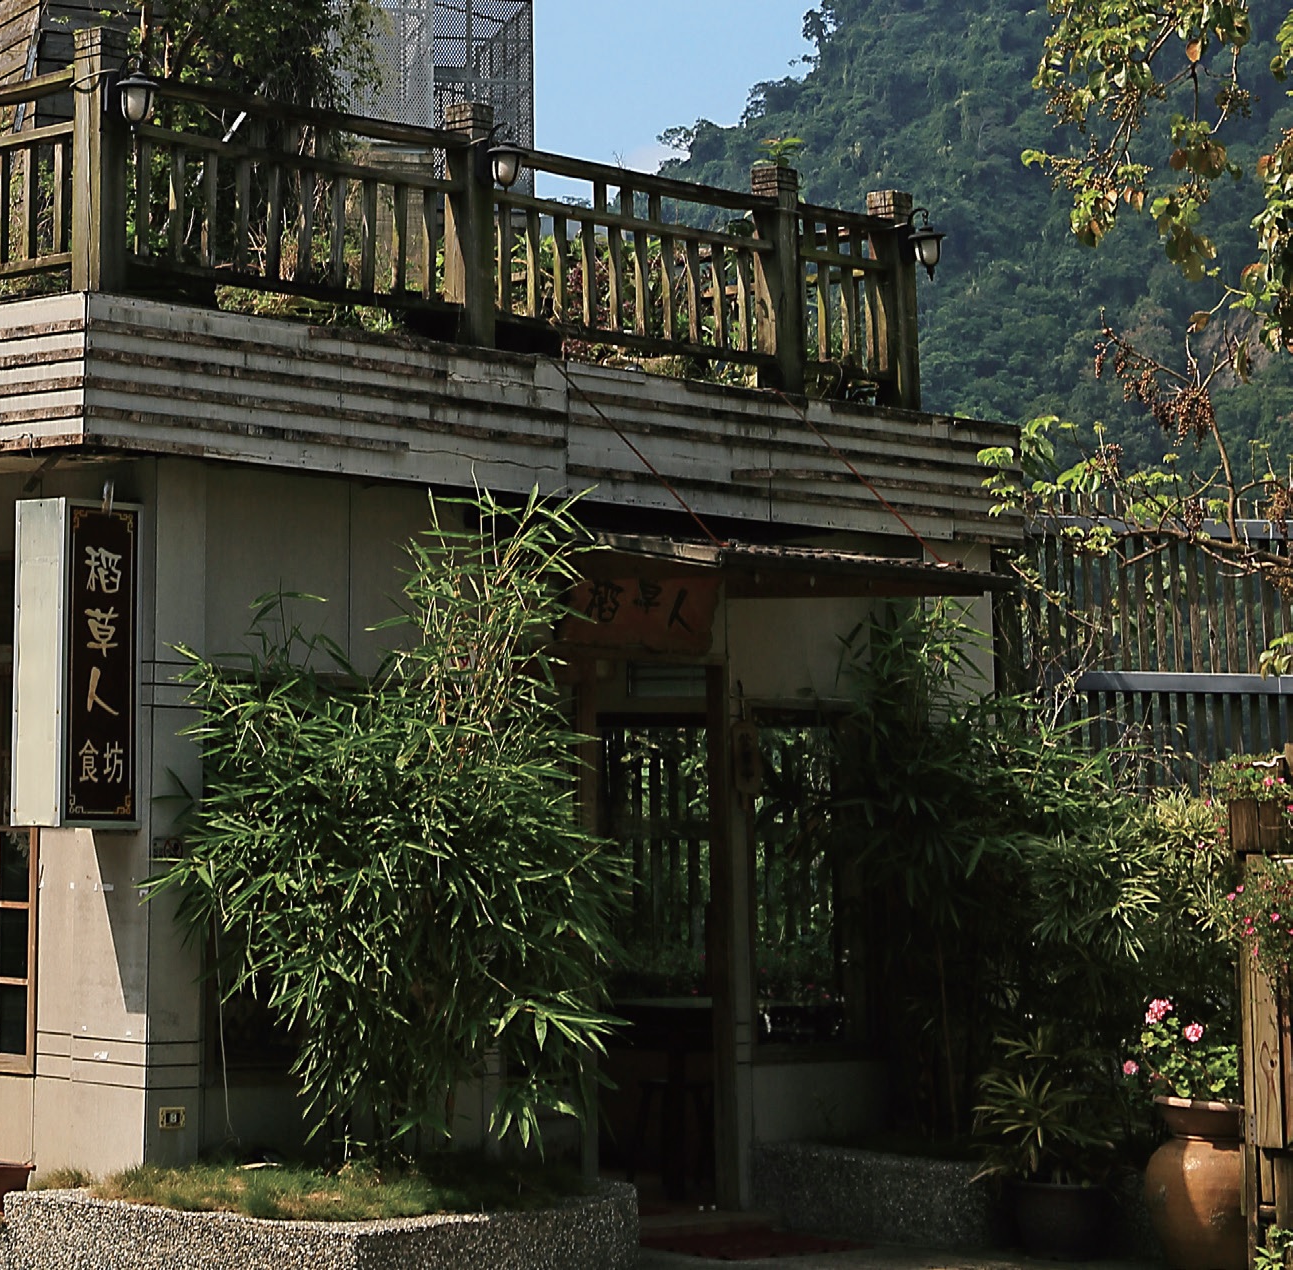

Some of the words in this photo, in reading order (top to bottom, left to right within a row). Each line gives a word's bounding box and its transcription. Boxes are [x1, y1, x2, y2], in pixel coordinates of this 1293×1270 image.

[84, 545, 122, 716] 稻草人
[78, 739, 123, 784] 食坊
